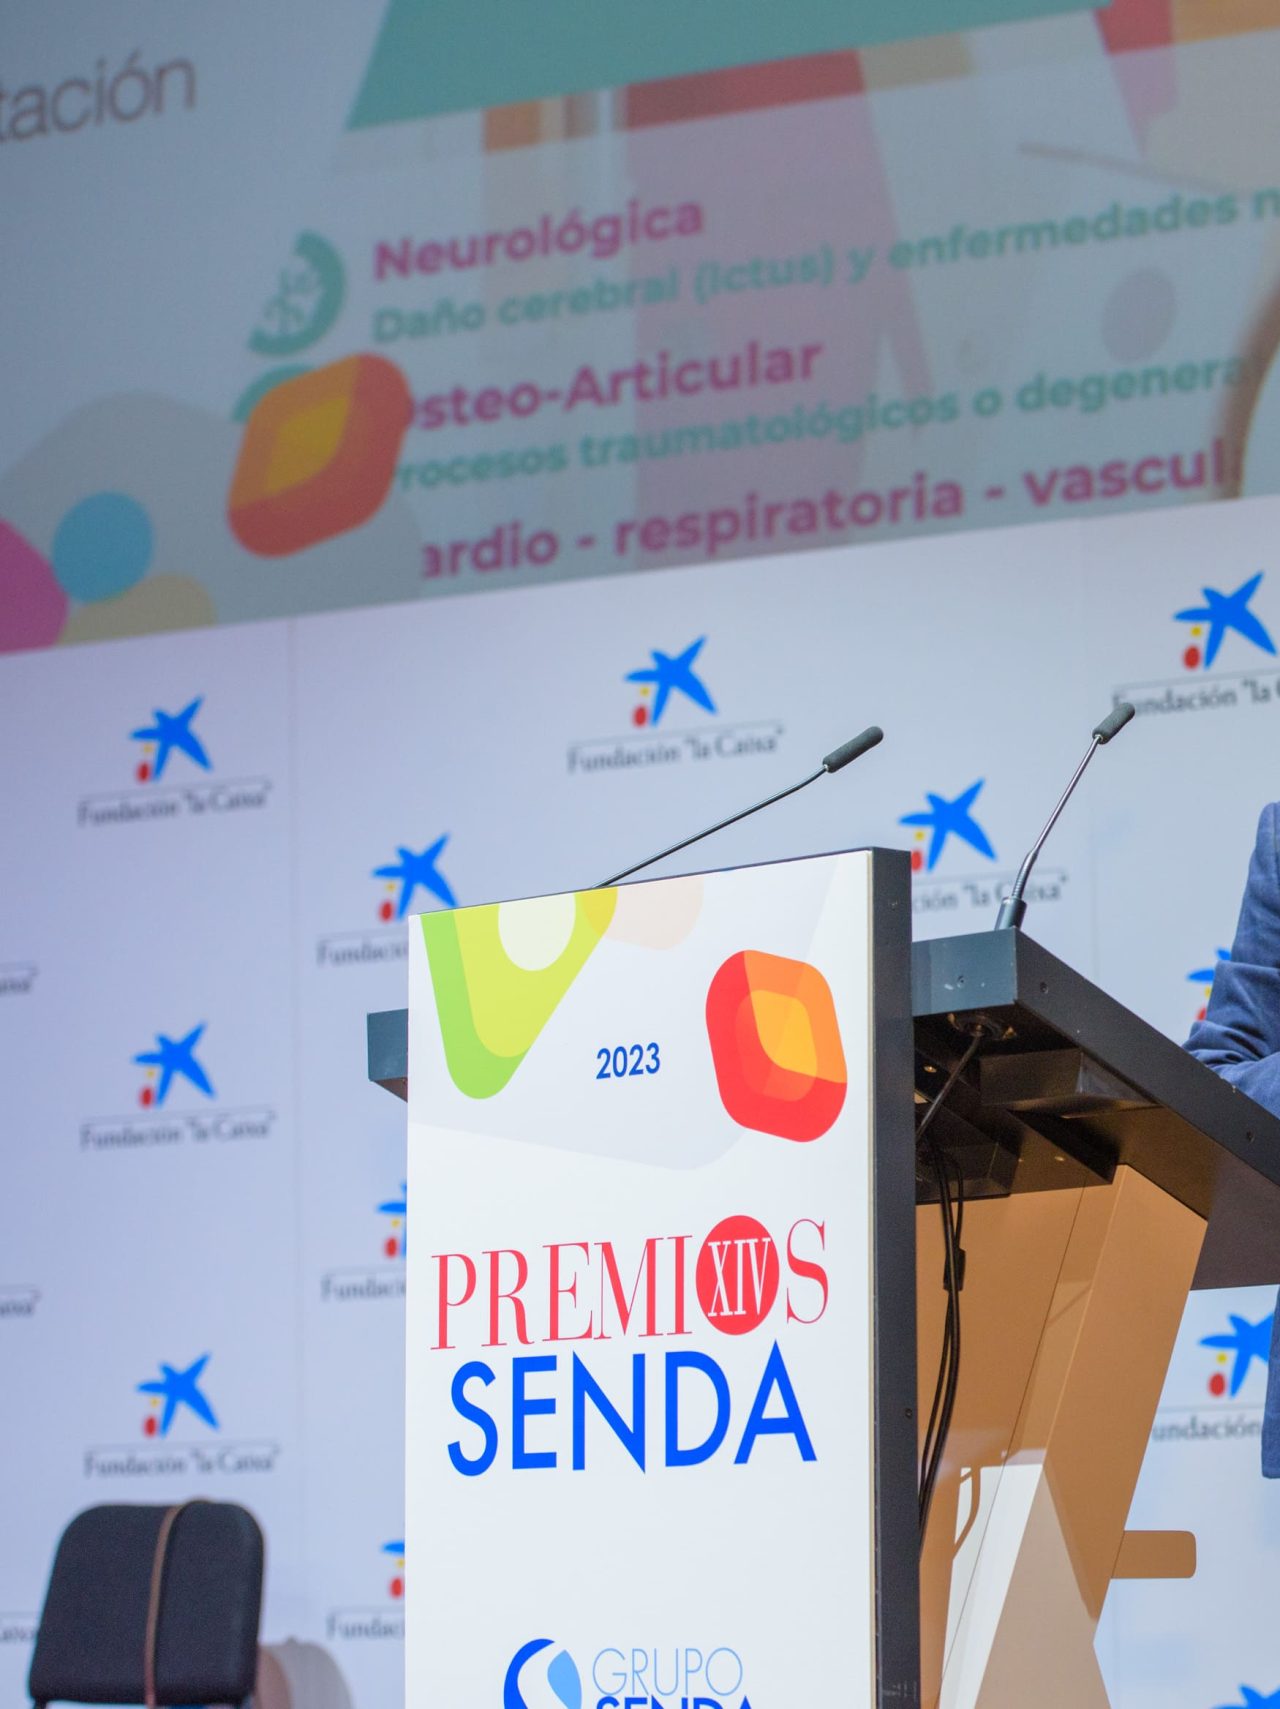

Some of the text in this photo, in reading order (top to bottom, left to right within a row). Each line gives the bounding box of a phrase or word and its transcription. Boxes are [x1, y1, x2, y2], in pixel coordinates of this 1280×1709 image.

[373, 296, 487, 343] Daño
[498, 267, 679, 324] cerebral
[848, 244, 876, 285] y
[888, 193, 1239, 269] enfermedades
[375, 198, 706, 281] Neurológica
[409, 340, 823, 431] steo-Articular
[398, 441, 568, 493] rocesos
[580, 388, 962, 467] traumatológicos
[971, 386, 1003, 419] o
[614, 471, 965, 558] respiratoria
[1022, 436, 1228, 507] vascul
[596, 1042, 660, 1079] 2023
[707, 1237, 772, 1317] XIV
[447, 1338, 818, 1477] SENDA
[592, 1647, 744, 1697] GRUPO
